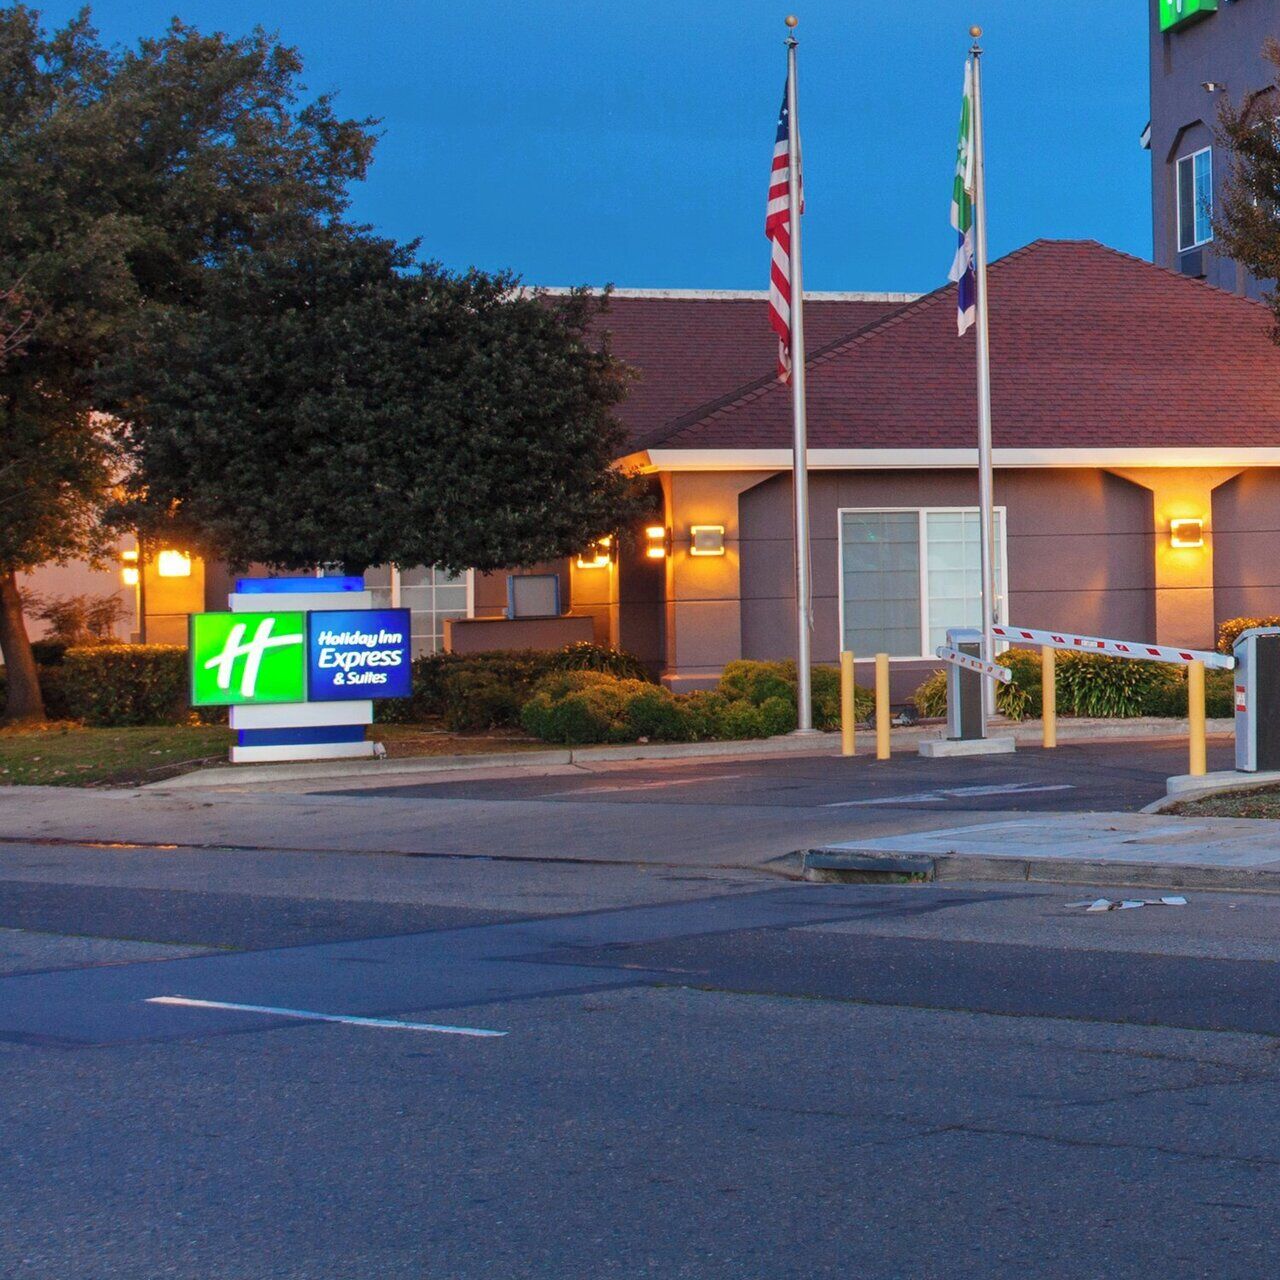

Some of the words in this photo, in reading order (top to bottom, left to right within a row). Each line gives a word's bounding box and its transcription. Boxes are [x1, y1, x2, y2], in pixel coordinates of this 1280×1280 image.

[318, 631, 376, 647] Holiday
[379, 629, 402, 644] Inn
[318, 648, 402, 672] Express
[333, 674, 344, 685] &
[346, 672, 388, 685] Suites
